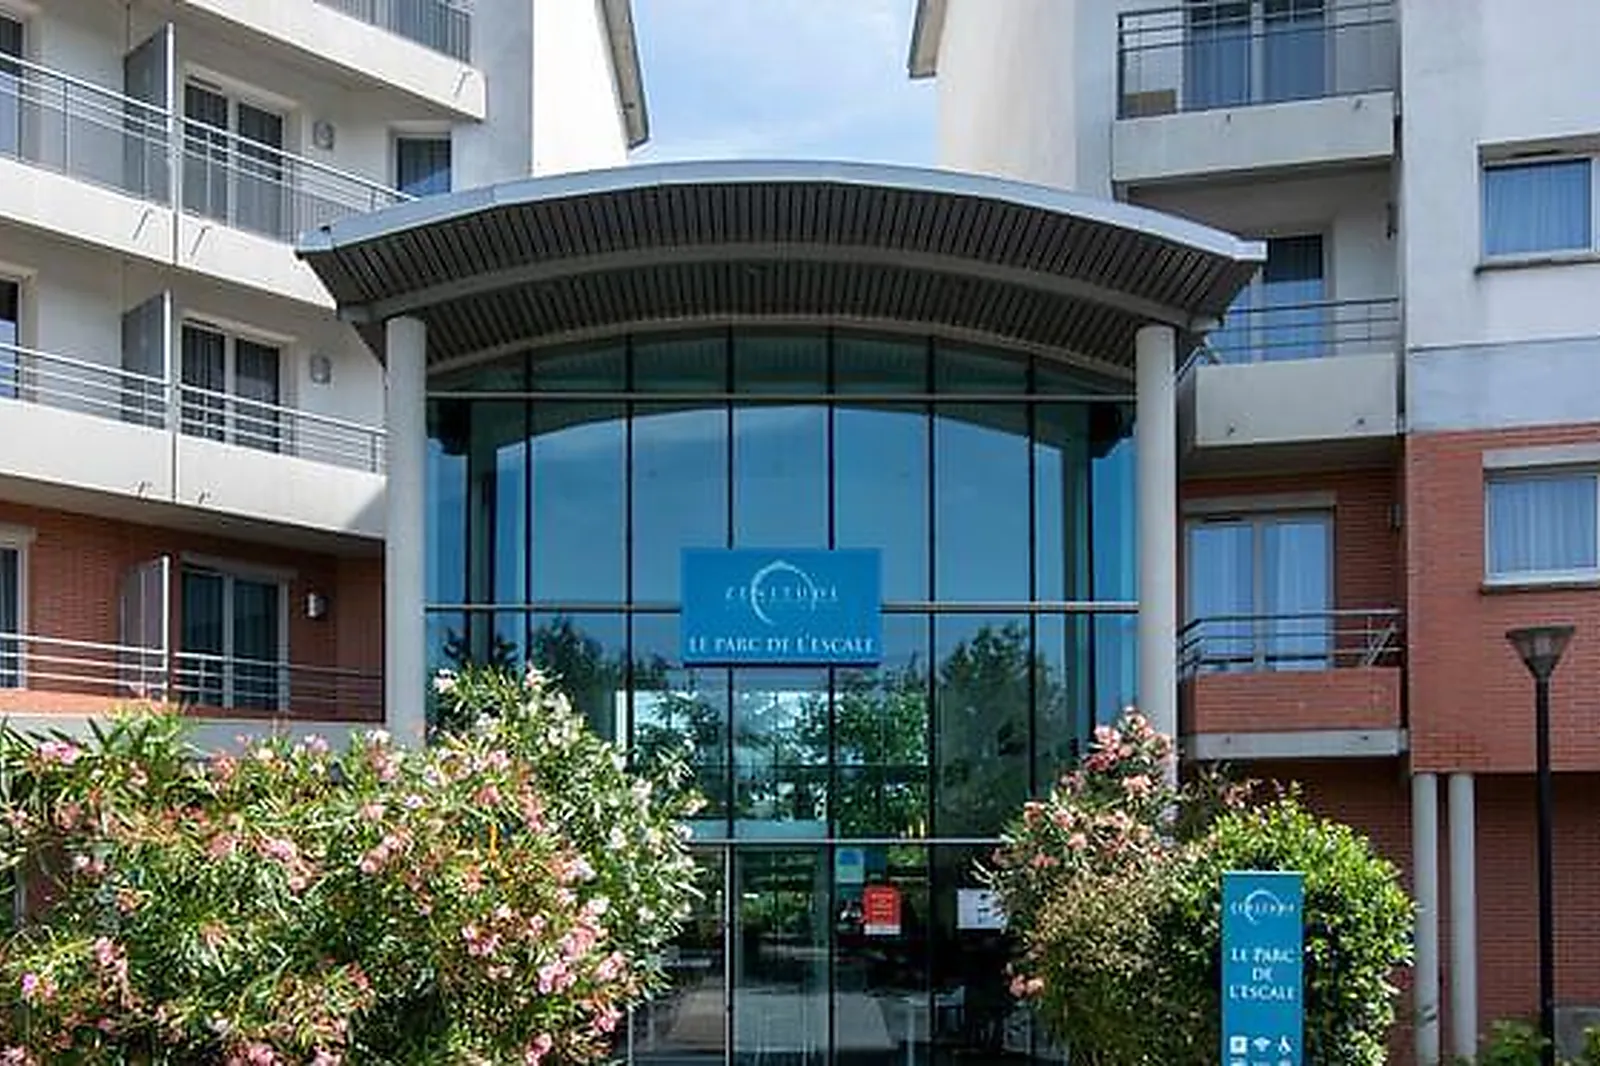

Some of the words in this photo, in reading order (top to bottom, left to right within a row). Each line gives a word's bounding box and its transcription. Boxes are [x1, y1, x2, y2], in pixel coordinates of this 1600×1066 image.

[689, 636, 705, 653] LE
[715, 636, 760, 653] PARC
[767, 636, 789, 653] DE
[797, 632, 874, 653] L'ESCALE
[1231, 947, 1247, 963] LE
[1253, 947, 1295, 963] PARC
[1252, 966, 1273, 982] DE
[1229, 984, 1294, 1000] L'ESCALE
